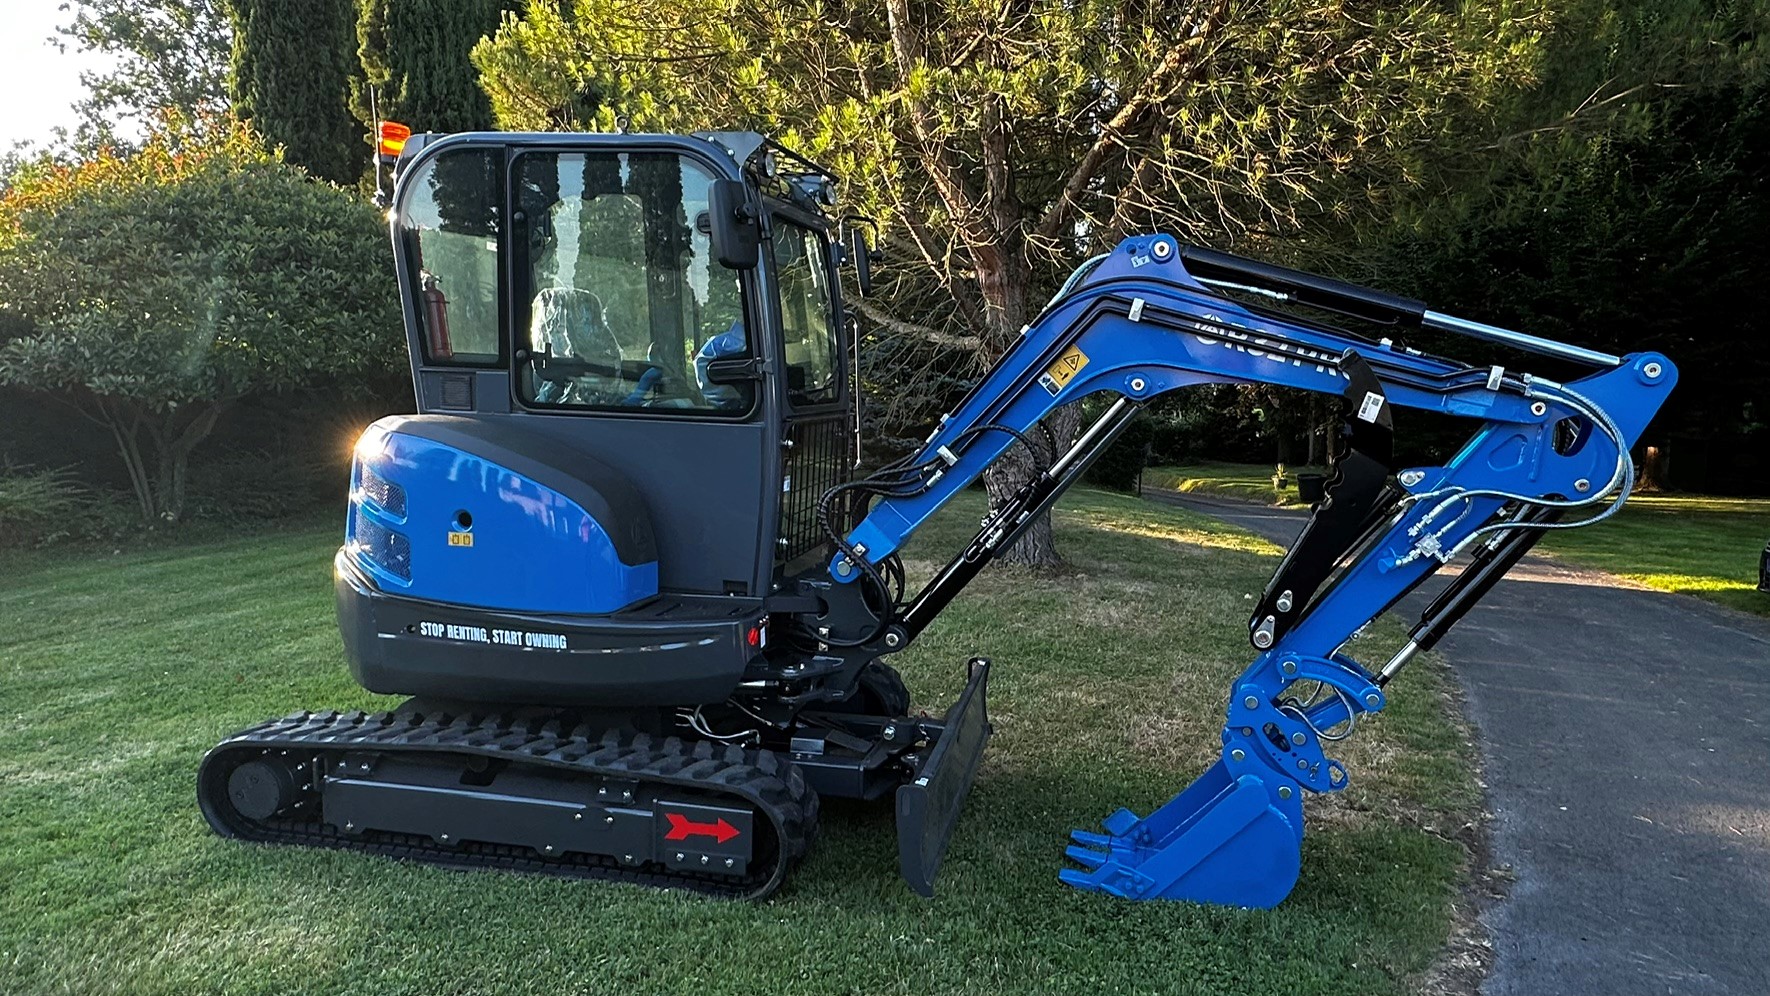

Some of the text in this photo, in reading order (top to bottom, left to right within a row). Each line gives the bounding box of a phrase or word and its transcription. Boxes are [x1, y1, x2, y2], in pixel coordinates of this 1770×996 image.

[420, 621, 568, 649] STOP RENTING, START OWNING
